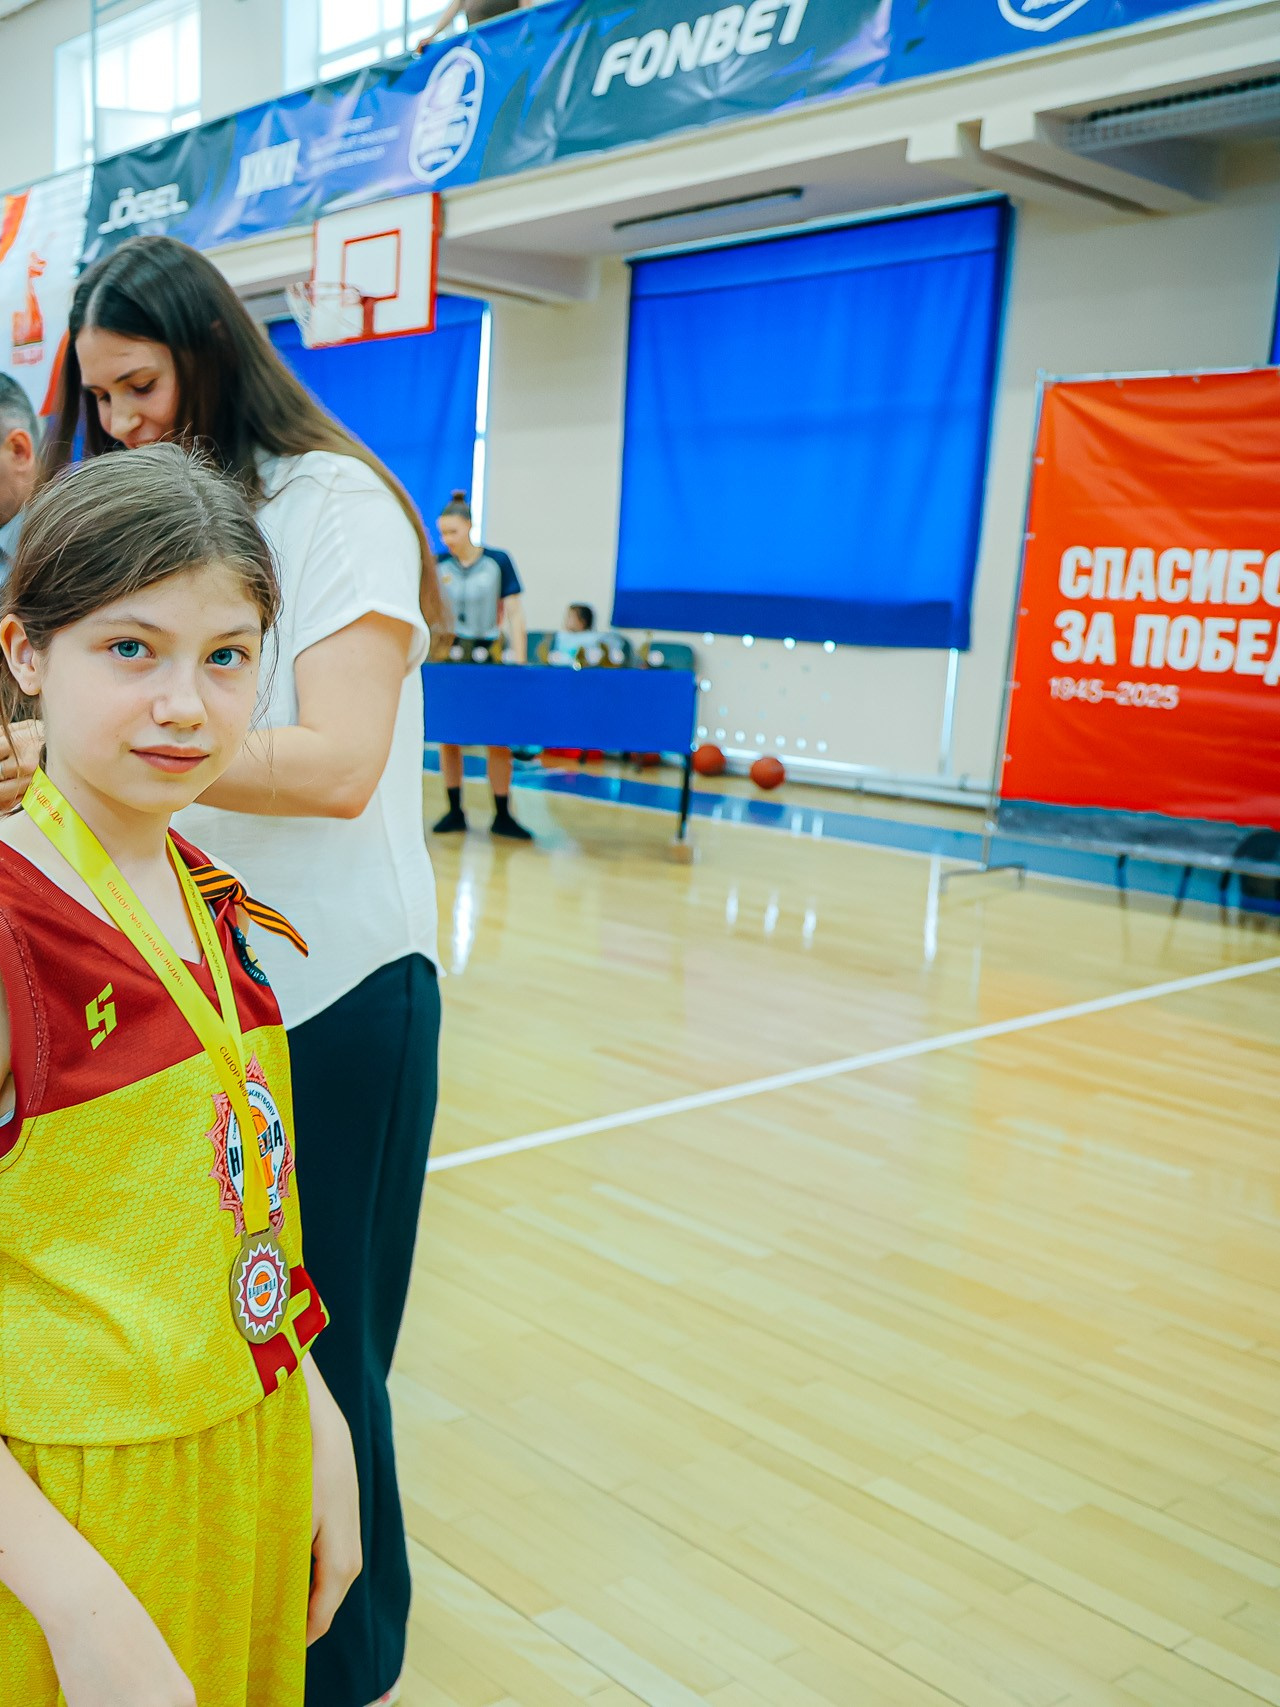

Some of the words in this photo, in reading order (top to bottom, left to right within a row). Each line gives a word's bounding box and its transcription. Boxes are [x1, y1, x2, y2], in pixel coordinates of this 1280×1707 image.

[591, 0, 808, 97] FONBET
[97, 183, 189, 235] JÖGEL
[1050, 609, 1116, 666] ЗА
[106, 881, 131, 912] СШОР
[219, 1046, 241, 1078] СШОР
